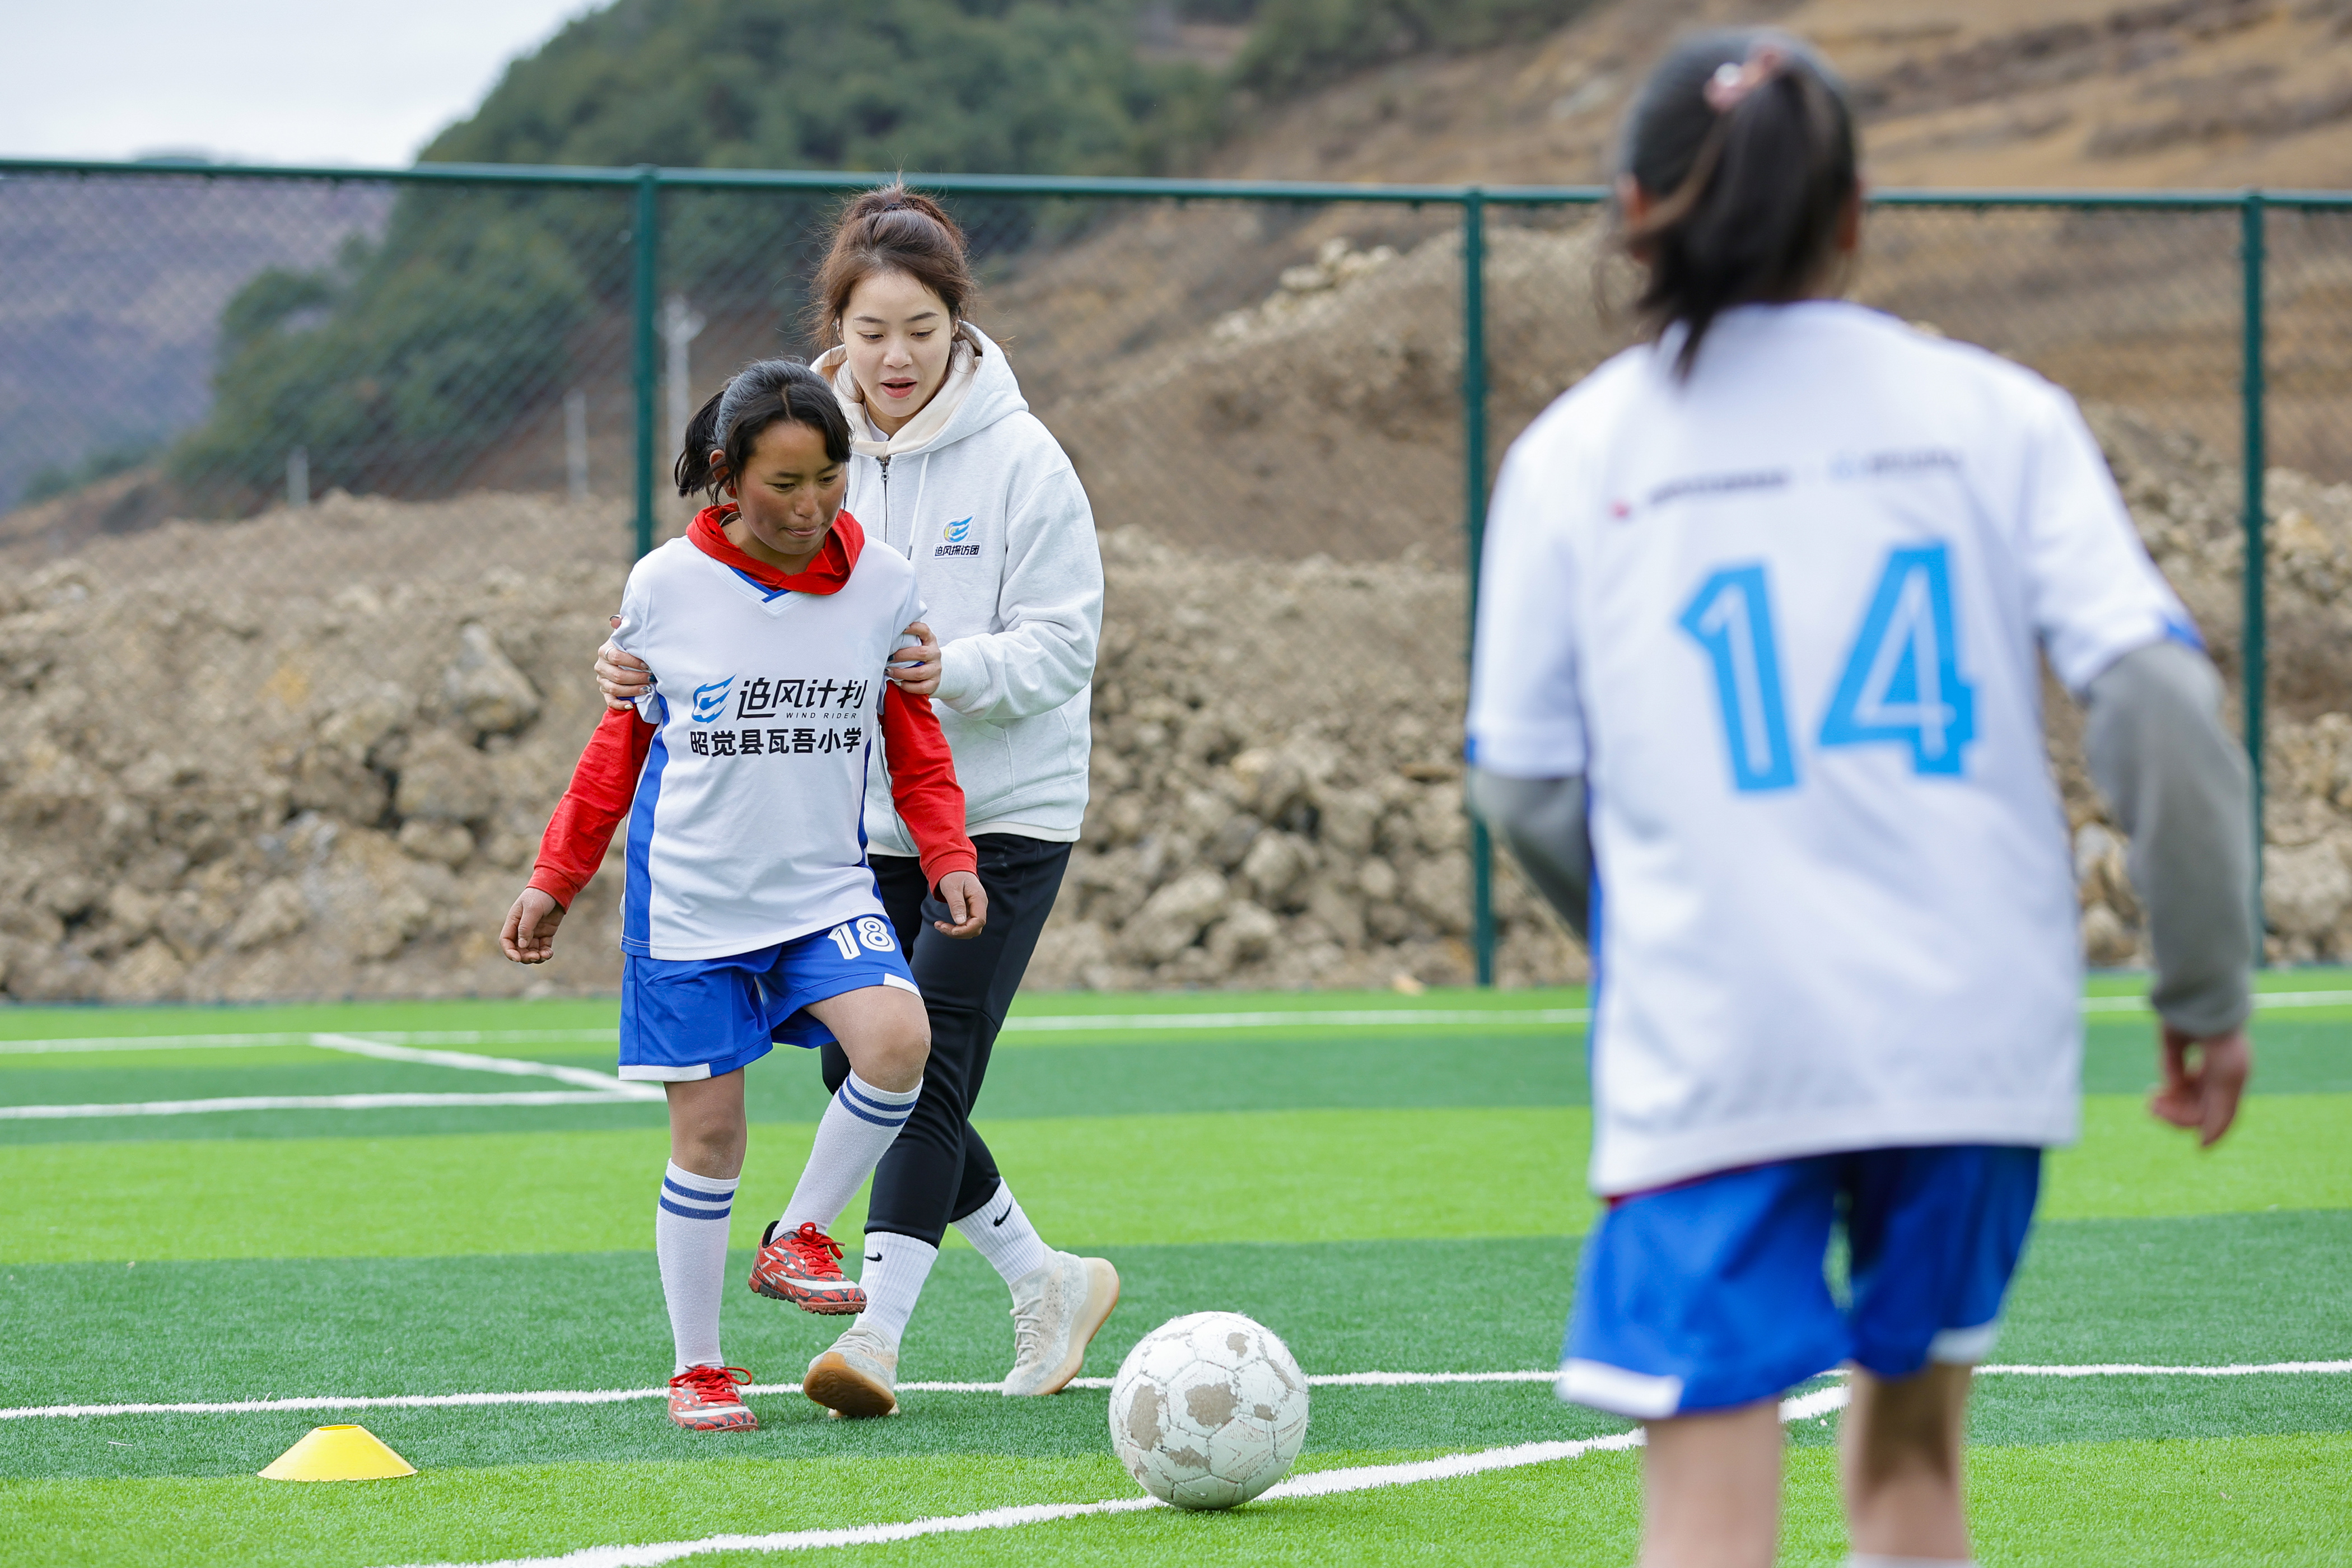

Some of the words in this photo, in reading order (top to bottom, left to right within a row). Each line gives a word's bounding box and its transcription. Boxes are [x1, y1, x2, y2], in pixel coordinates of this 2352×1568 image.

[1677, 543, 1976, 792] 14
[736, 677, 868, 721] 追风计划
[690, 727, 862, 757] 昭觉县瓦吾小学
[828, 916, 895, 960] 18
